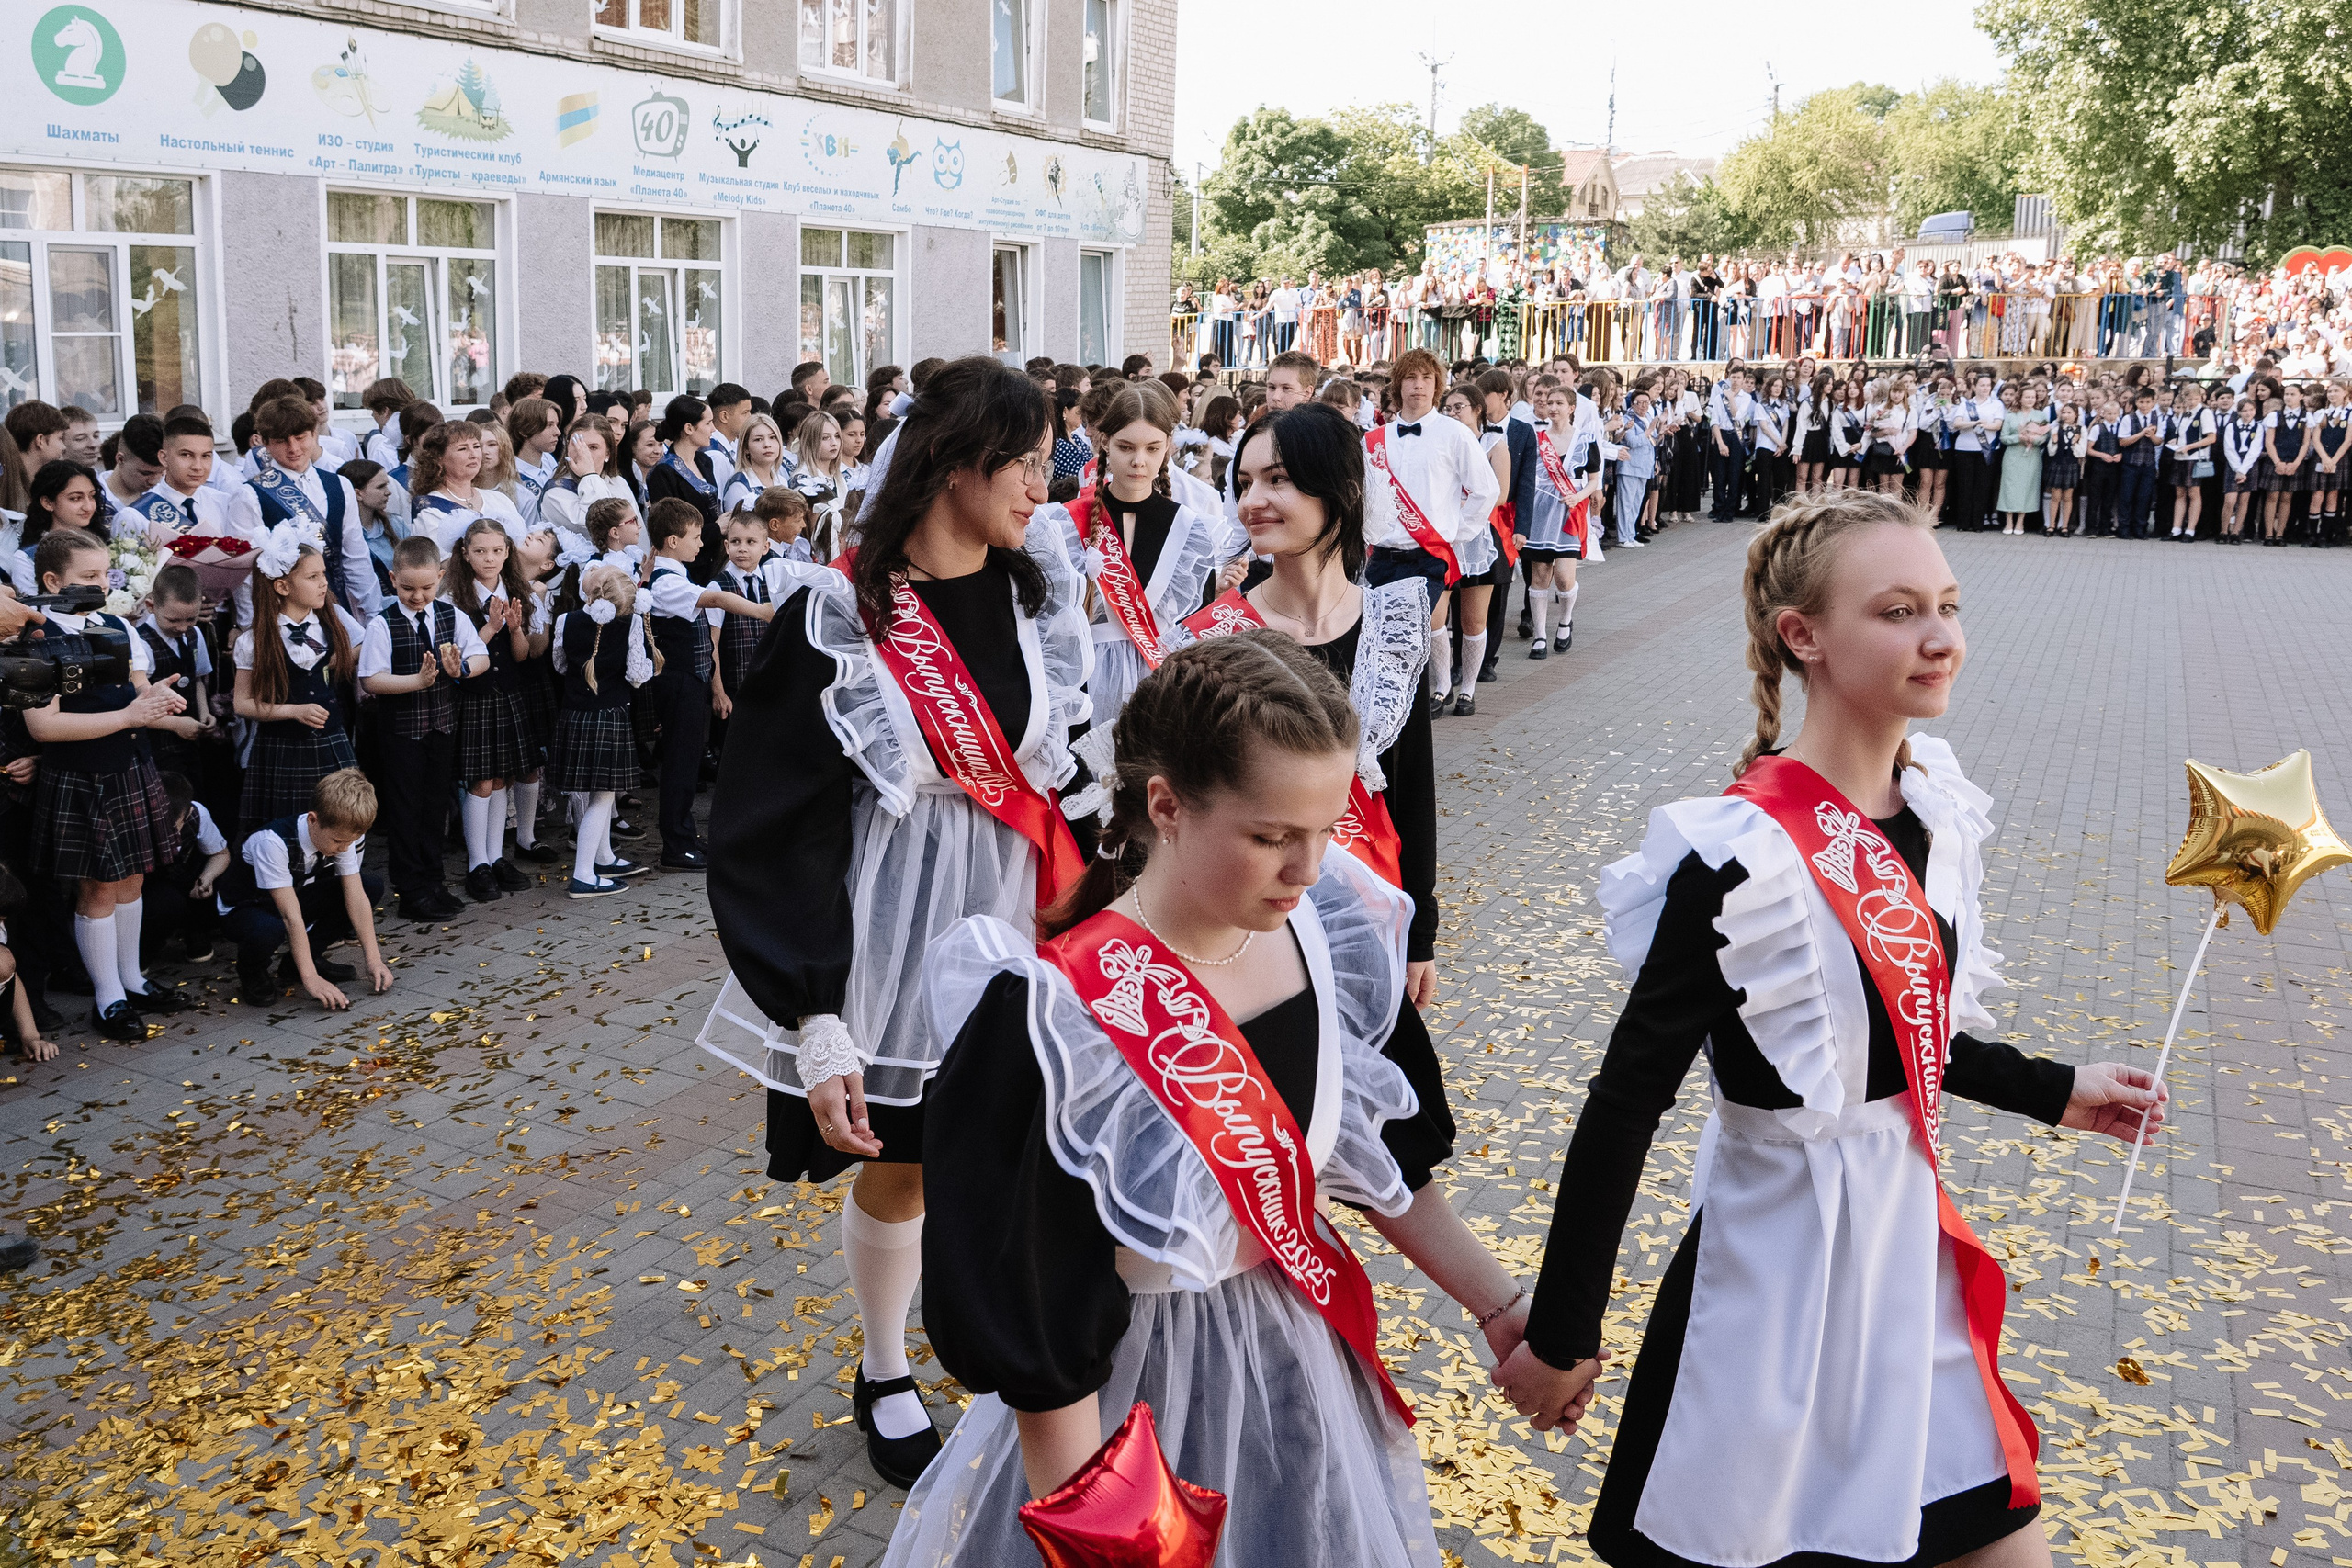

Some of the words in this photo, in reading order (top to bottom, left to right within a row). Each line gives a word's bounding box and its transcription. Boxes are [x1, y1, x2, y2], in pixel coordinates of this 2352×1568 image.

[46, 123, 119, 143] Шахматы
[640, 110, 673, 143] 40
[159, 133, 245, 154] Настольный
[249, 144, 295, 158] теннис
[318, 133, 344, 148] ИЗО
[355, 140, 394, 153] студия
[413, 142, 495, 162] Туристический
[498, 152, 522, 166] клуб
[308, 155, 336, 172] «Арт
[348, 158, 404, 175] Палитра»
[408, 164, 461, 181] «Туристы
[471, 172, 527, 185] краеведы»
[633, 164, 685, 183] Медиацентр
[538, 170, 593, 186] Армянский
[594, 177, 617, 187] язык
[698, 172, 752, 187] Музыкальная
[753, 180, 779, 191] студия
[629, 184, 672, 197] «Планета
[673, 187, 688, 199] 40»
[712, 191, 744, 205] «Melody
[745, 194, 766, 206] Kids»
[783, 180, 801, 194] Клуб
[801, 185, 832, 196] веселых
[839, 188, 880, 200] находчивых
[808, 200, 842, 212] «Планета
[891, 202, 912, 214] Самбо
[924, 206, 939, 216] Что?
[939, 207, 954, 218] Где?
[954, 209, 974, 220] Когда?
[882, 609, 992, 772] Выпускница
[1856, 888, 1942, 1112] Выпускник
[1148, 1021, 1288, 1242] Выпускник
[1279, 1228, 1337, 1306] 2025
